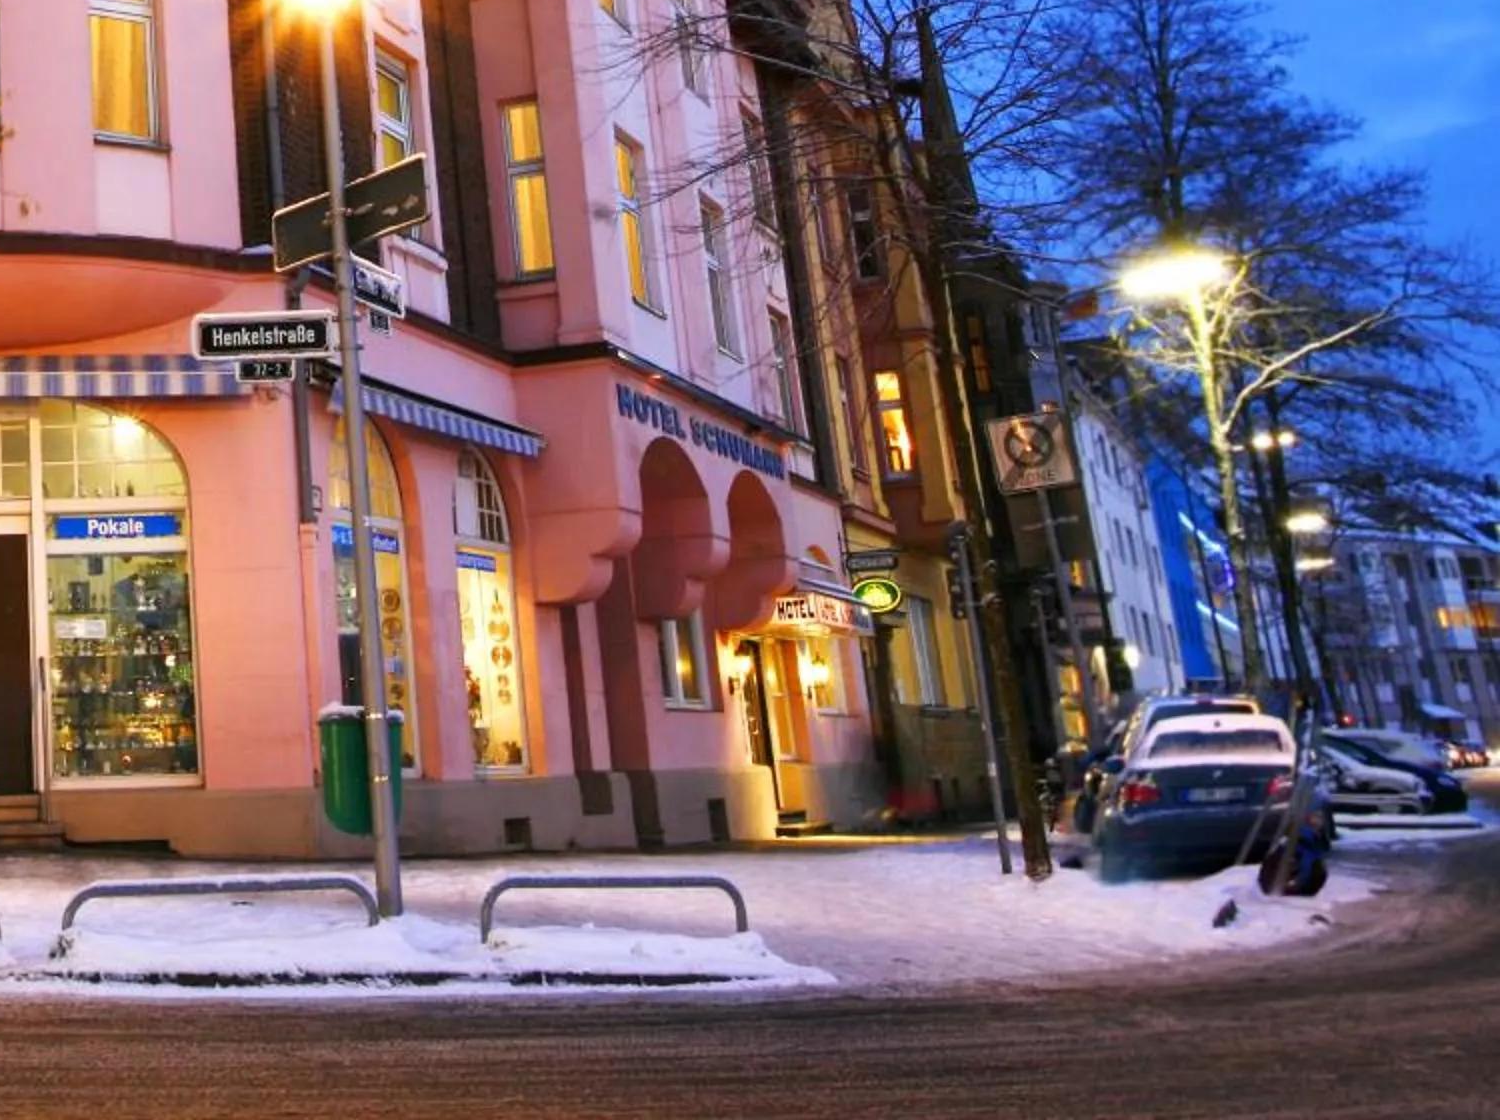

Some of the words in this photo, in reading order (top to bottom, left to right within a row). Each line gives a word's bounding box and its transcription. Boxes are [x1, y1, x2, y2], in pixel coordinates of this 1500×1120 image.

[212, 324, 316, 347] Henkelstraße
[615, 383, 687, 441] HOTEL
[689, 414, 786, 481] SCHUMANN
[87, 518, 145, 535] Pokale
[776, 598, 816, 621] HOTEL
